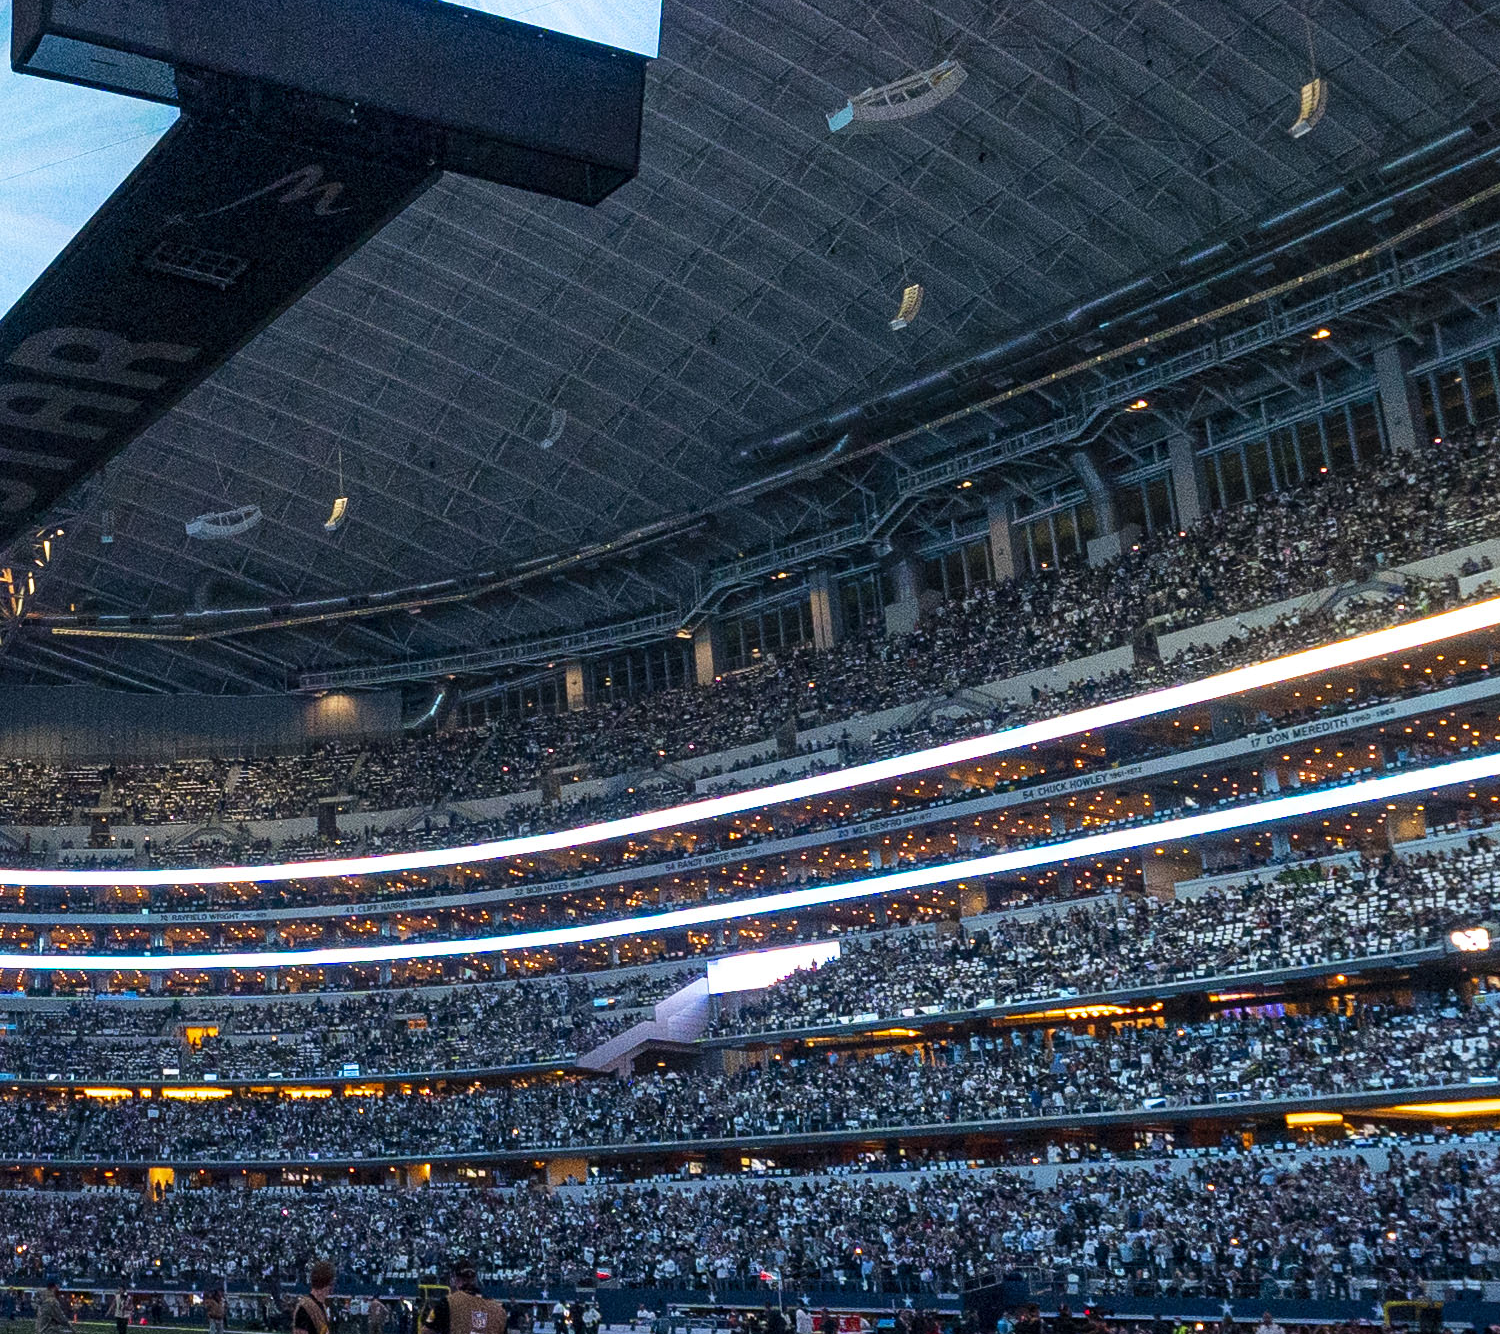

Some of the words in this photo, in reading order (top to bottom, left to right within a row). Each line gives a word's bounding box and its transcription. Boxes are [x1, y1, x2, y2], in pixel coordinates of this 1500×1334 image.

[1250, 738, 1261, 748] 17
[1266, 731, 1289, 745] DON
[1292, 717, 1349, 739] MEREDITH
[1022, 790, 1034, 800] 54
[1037, 781, 1068, 796] CHUCK
[1069, 772, 1108, 789] HOWLEY
[704, 852, 730, 864] WHITE
[544, 881, 569, 892] HAYES
[171, 913, 208, 921] RAYFIELD
[209, 912, 241, 920] WRIGHT
